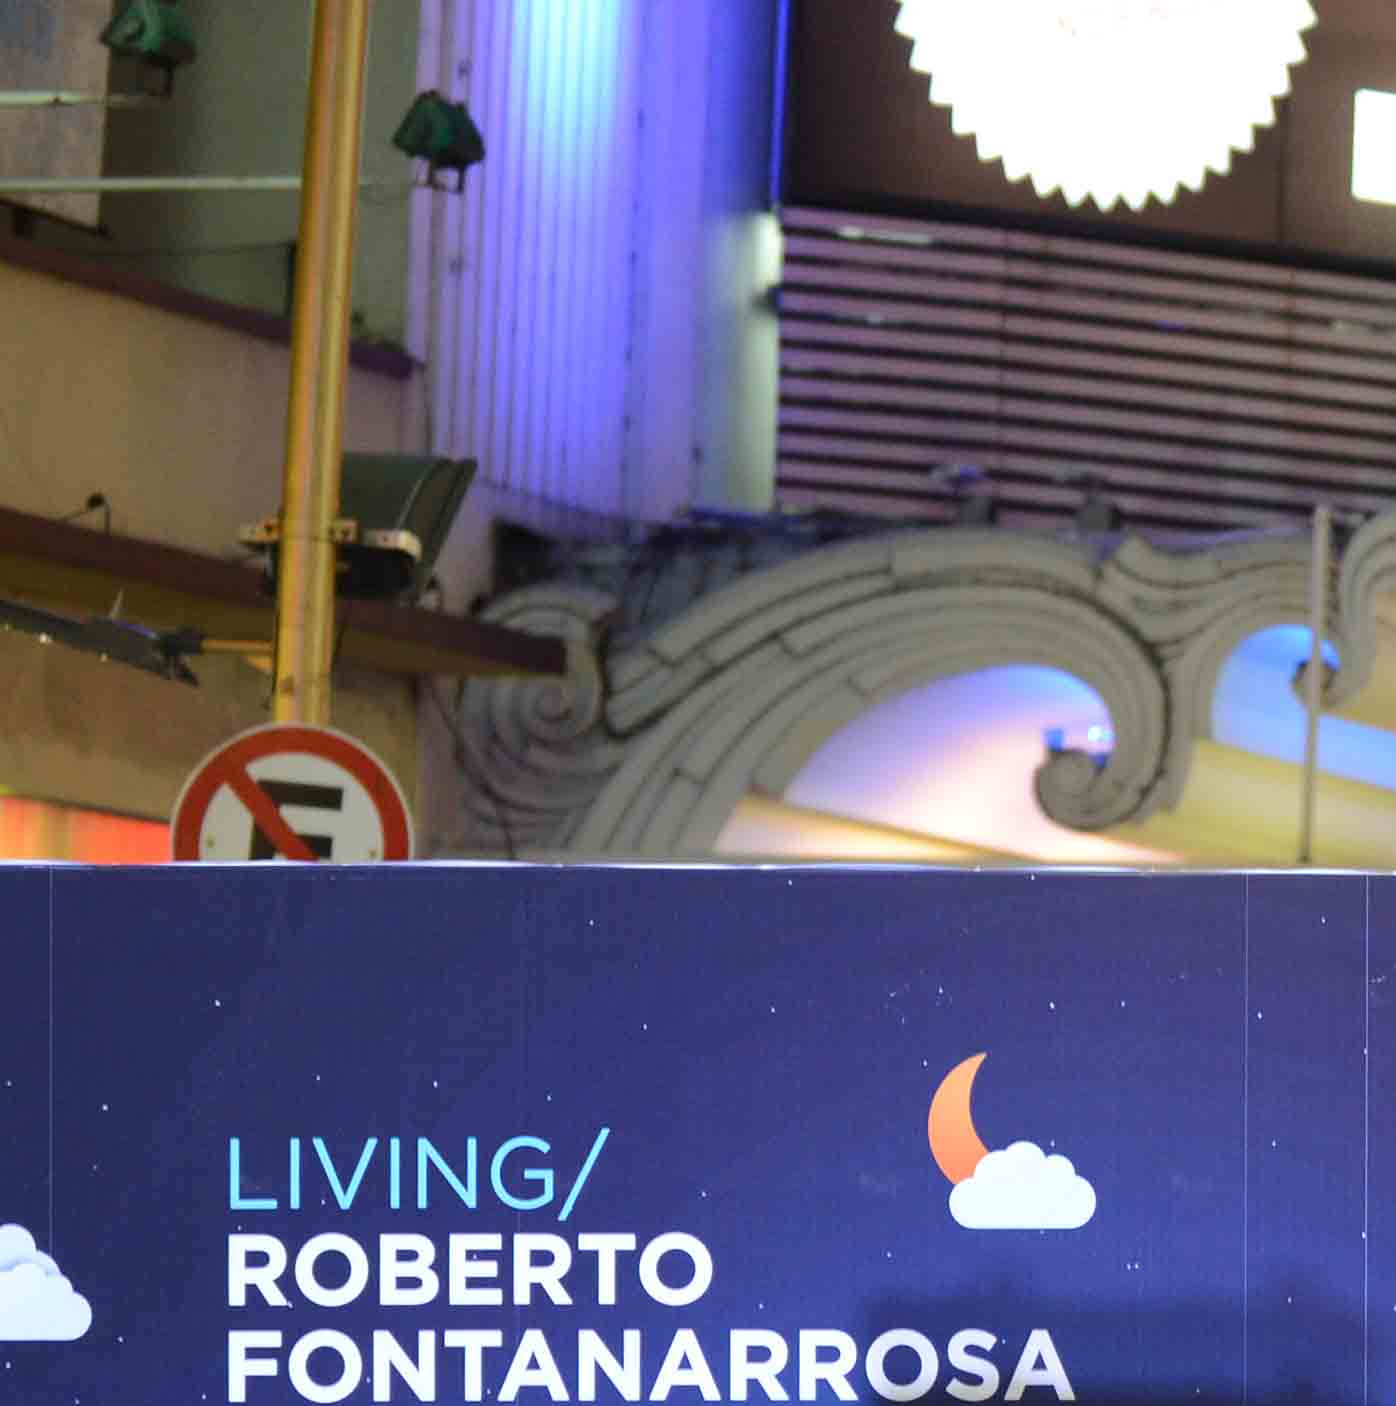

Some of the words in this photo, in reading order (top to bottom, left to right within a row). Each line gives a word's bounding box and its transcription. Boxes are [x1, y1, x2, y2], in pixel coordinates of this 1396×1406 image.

[229, 1127, 610, 1221] LIVING/
[228, 1231, 714, 1307] ROBERTO
[228, 1328, 1076, 1404] FONTANARROSA
